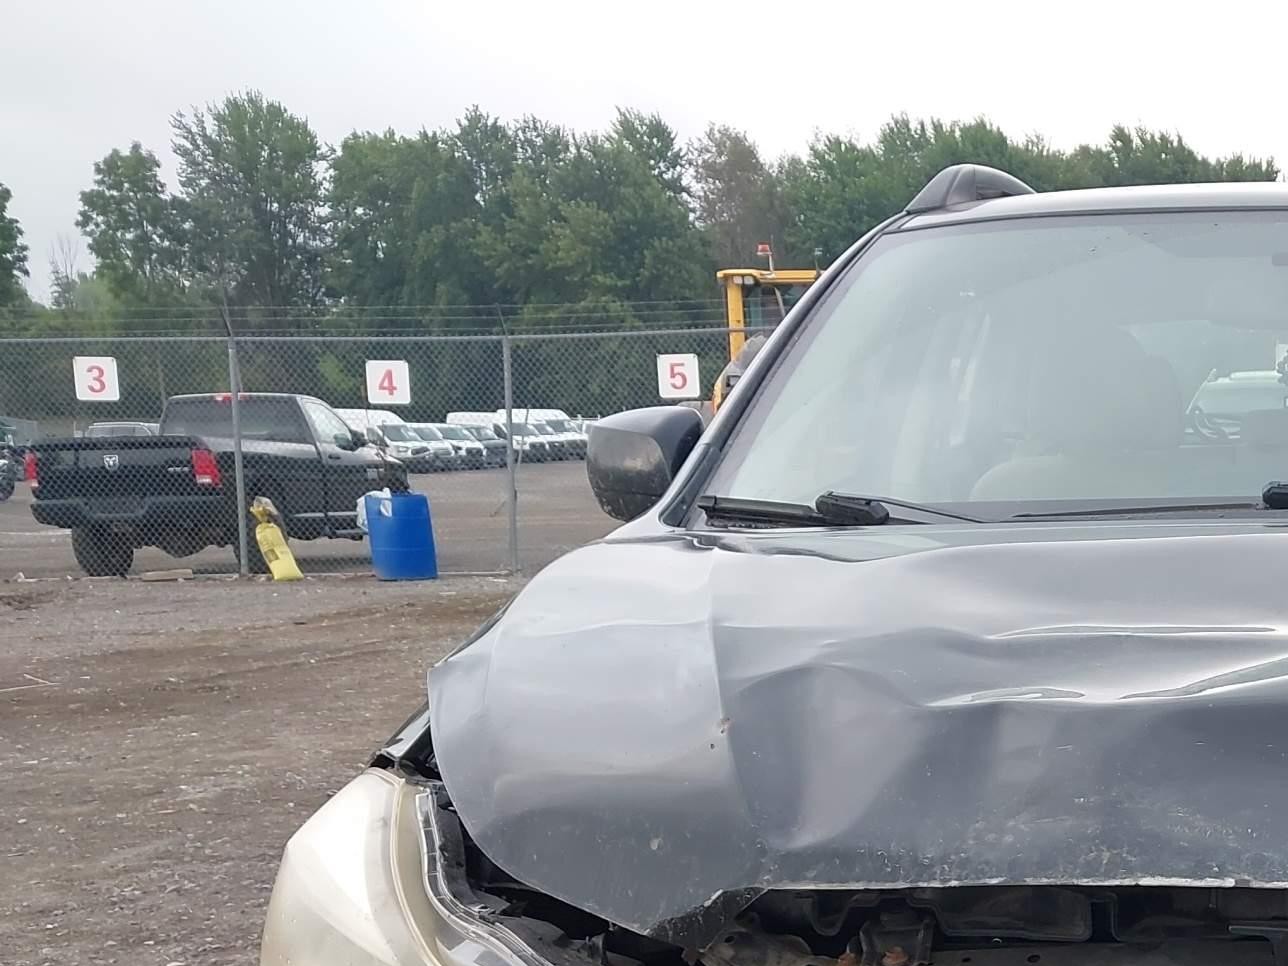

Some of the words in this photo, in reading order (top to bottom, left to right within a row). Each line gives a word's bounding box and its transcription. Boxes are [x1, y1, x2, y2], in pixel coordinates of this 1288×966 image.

[86, 365, 106, 393] 3
[378, 368, 398, 395] 4
[669, 362, 688, 389] 5
